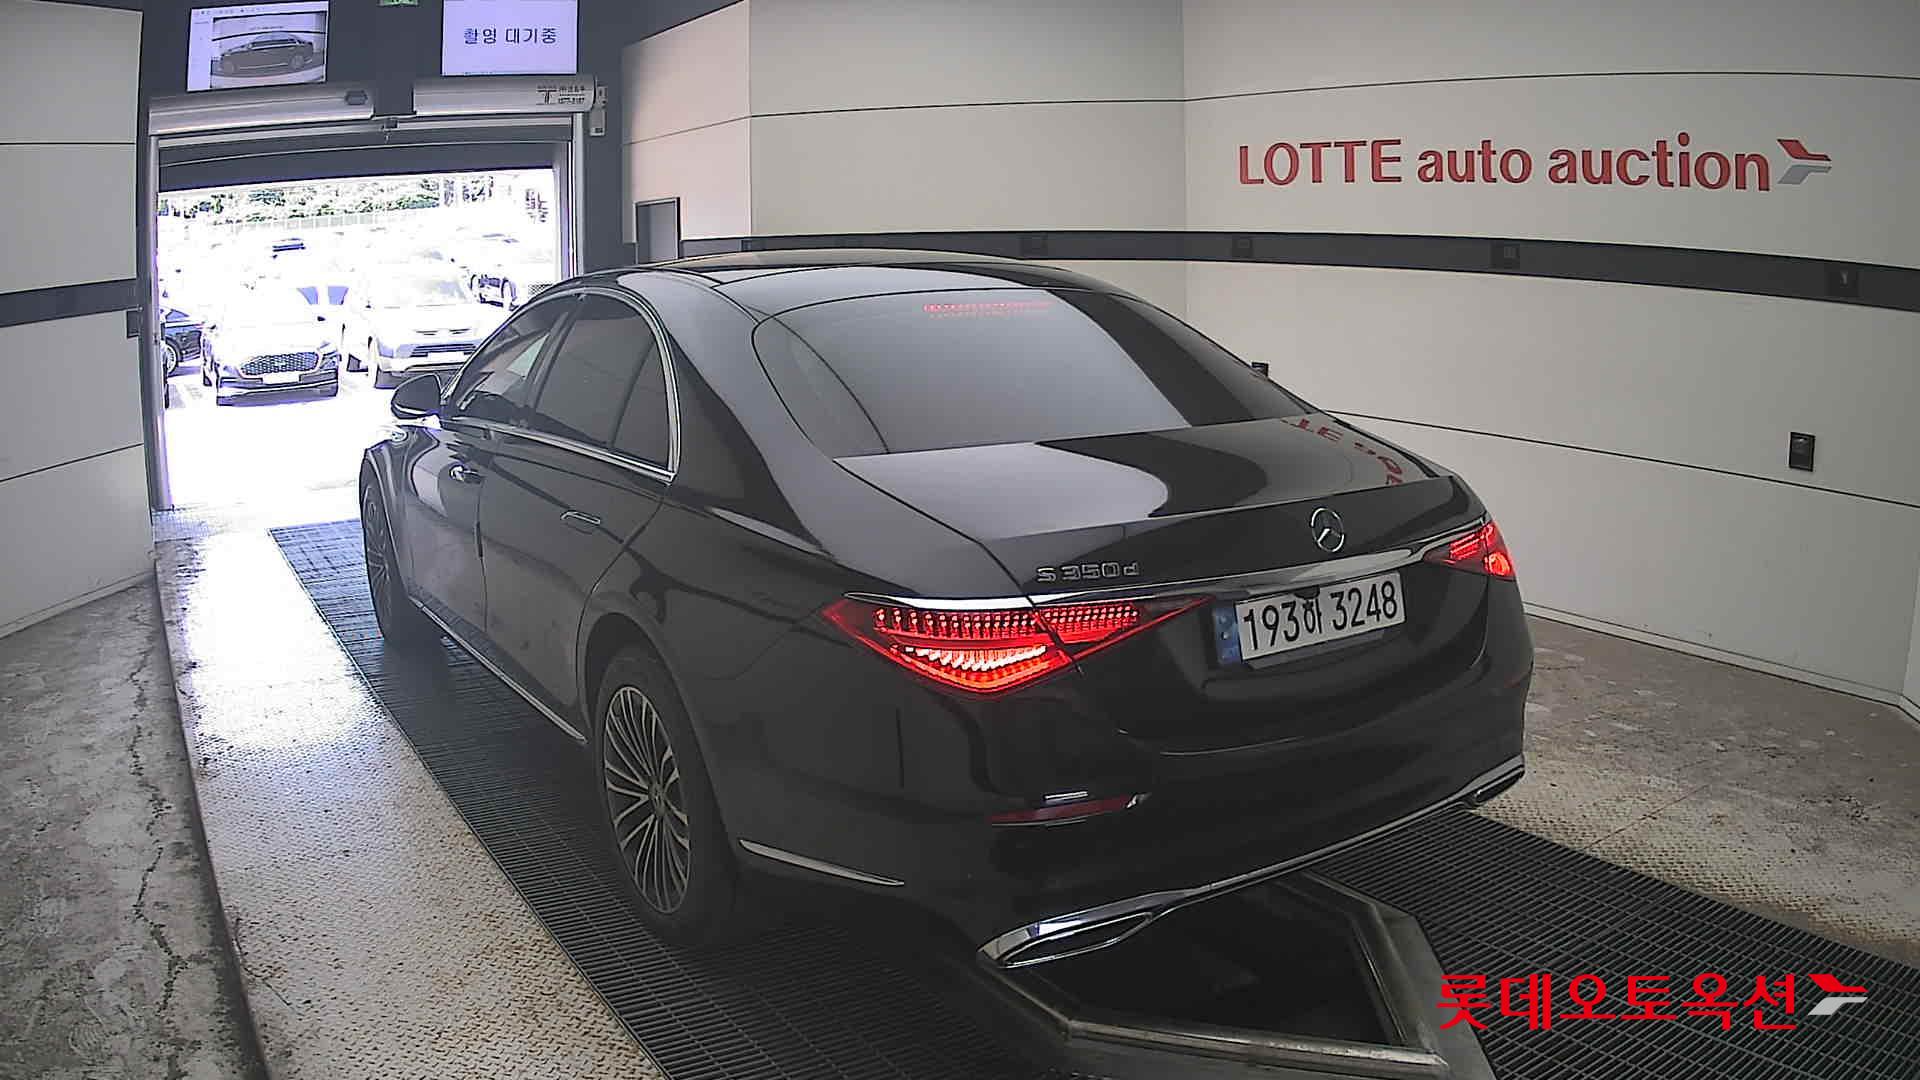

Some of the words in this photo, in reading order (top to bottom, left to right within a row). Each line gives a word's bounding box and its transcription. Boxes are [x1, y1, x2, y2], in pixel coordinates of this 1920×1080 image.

[505, 28, 557, 44] 대기중
[1239, 139, 1401, 185] LOTTE
[1417, 139, 1532, 184] auto
[1548, 132, 1770, 191] auction
[1330, 580, 1398, 631] 3248
